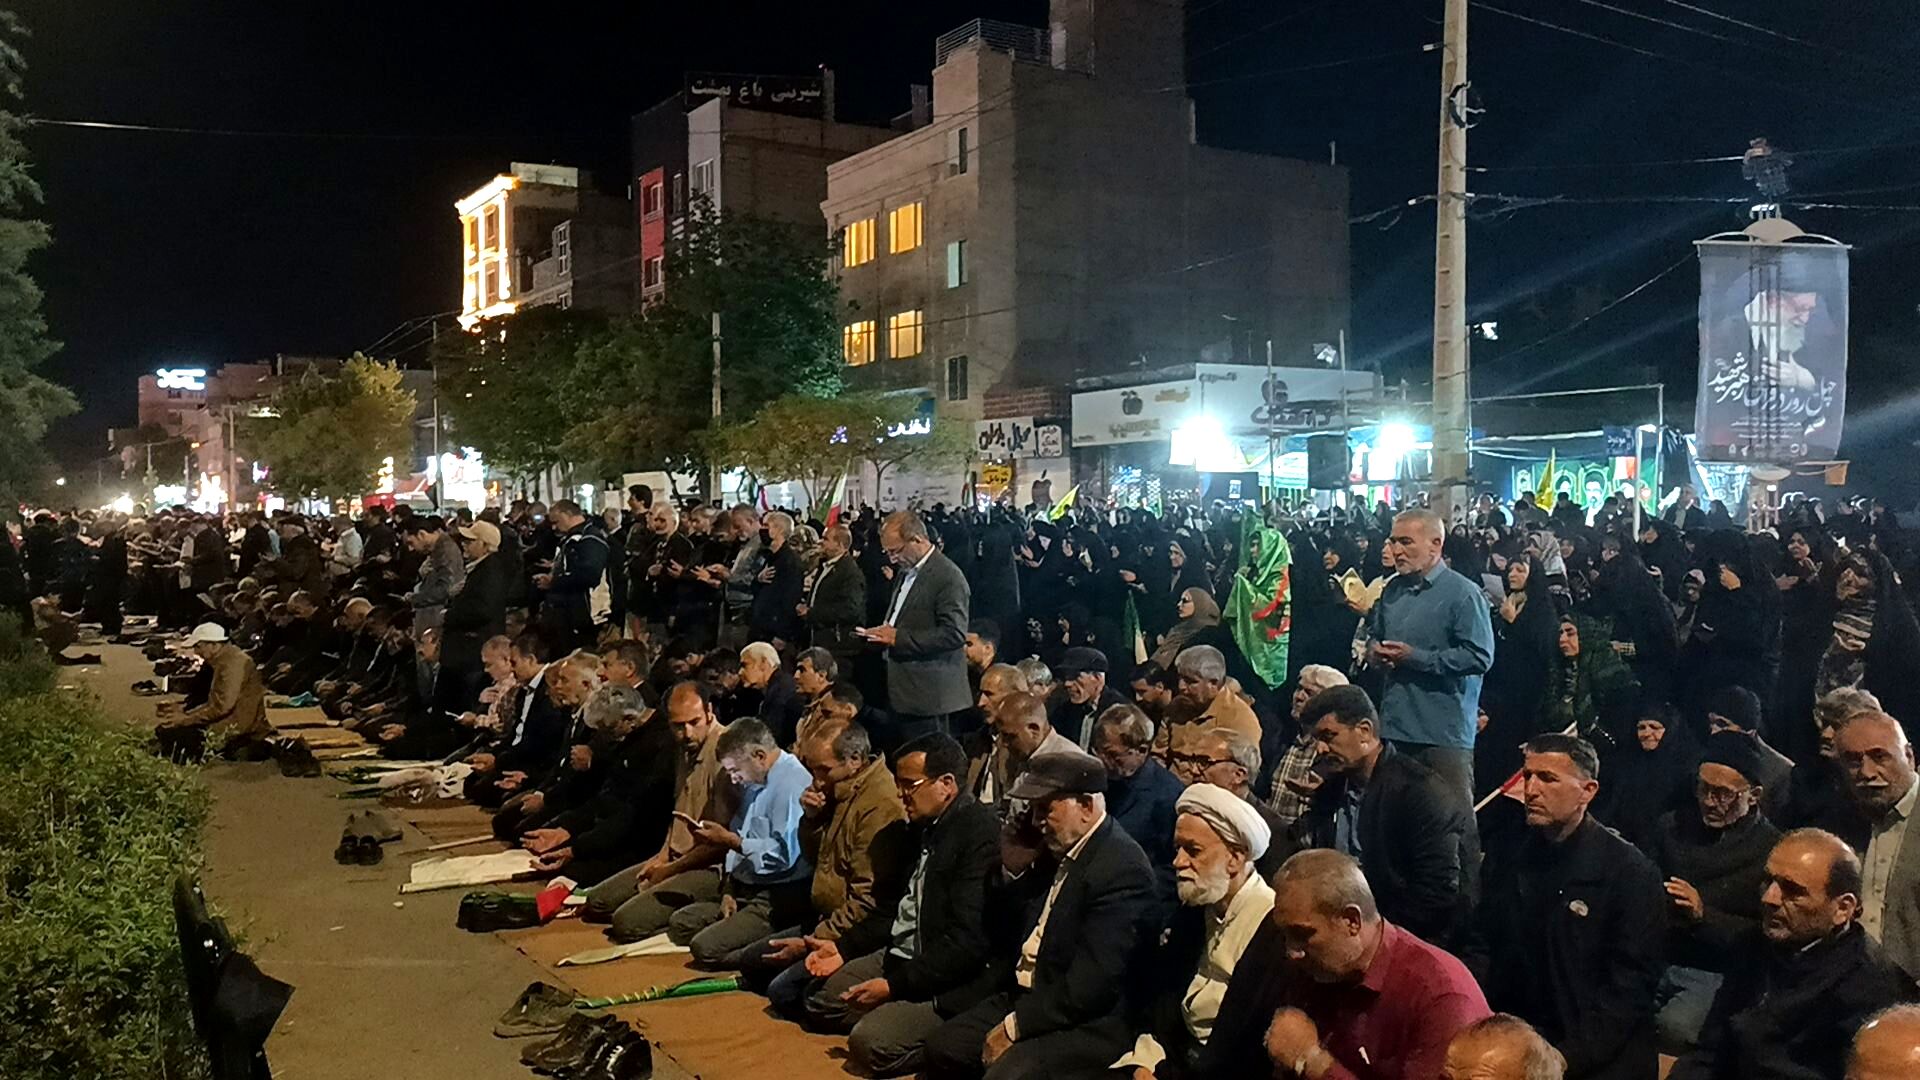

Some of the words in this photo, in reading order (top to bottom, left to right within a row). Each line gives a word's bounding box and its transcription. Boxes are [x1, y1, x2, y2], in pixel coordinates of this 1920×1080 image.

[691, 79, 731, 97] بهشت
[738, 79, 763, 104] باغ
[771, 81, 822, 103] شیرینی
[1708, 352, 1749, 393] شهید
[1716, 372, 1750, 403] رهبر
[1781, 387, 1805, 414] روز
[1805, 377, 1837, 416] چهل
